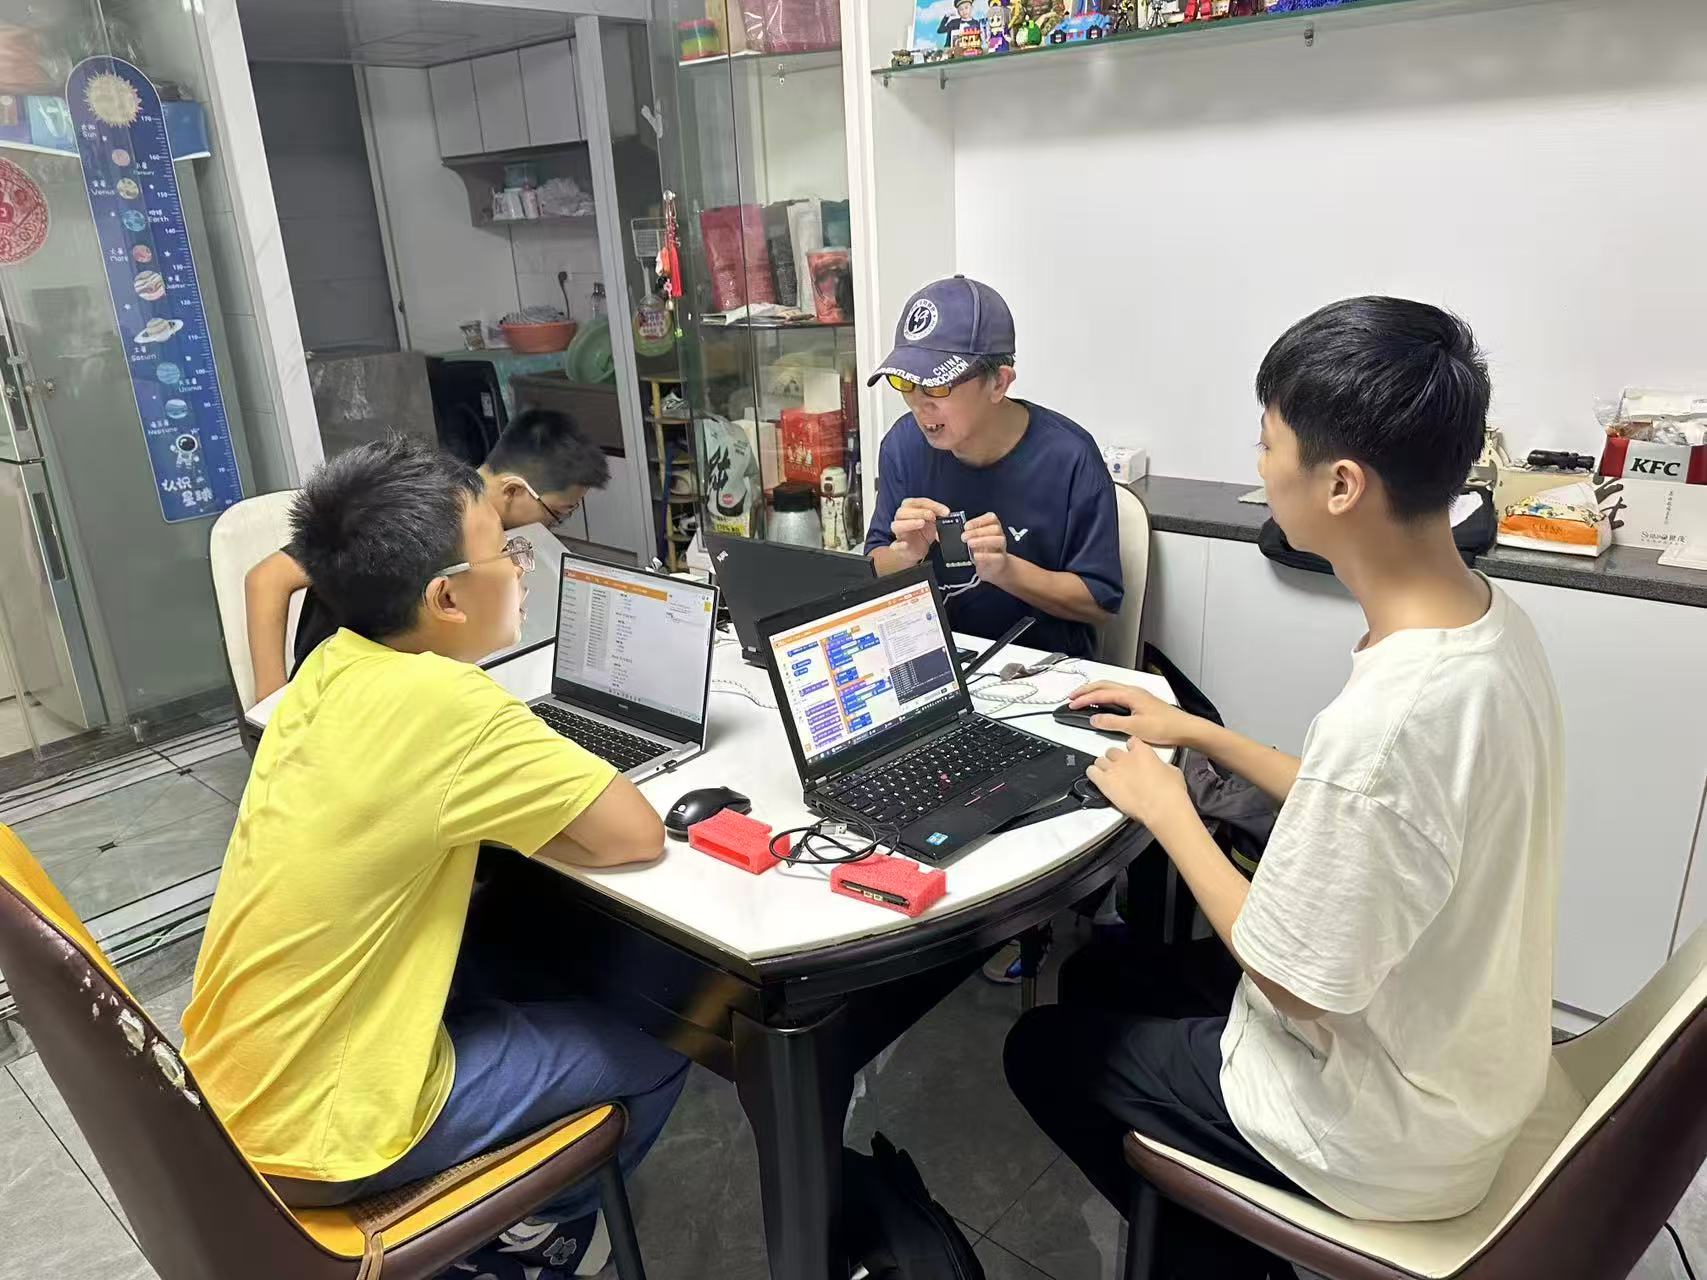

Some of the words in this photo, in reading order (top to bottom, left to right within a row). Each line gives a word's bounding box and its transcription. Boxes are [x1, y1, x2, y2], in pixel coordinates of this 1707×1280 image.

[147, 215, 169, 223] Earth
[921, 360, 970, 387] ASSOCIATION
[932, 354, 962, 376] CHINA
[1630, 457, 1681, 477] KFC
